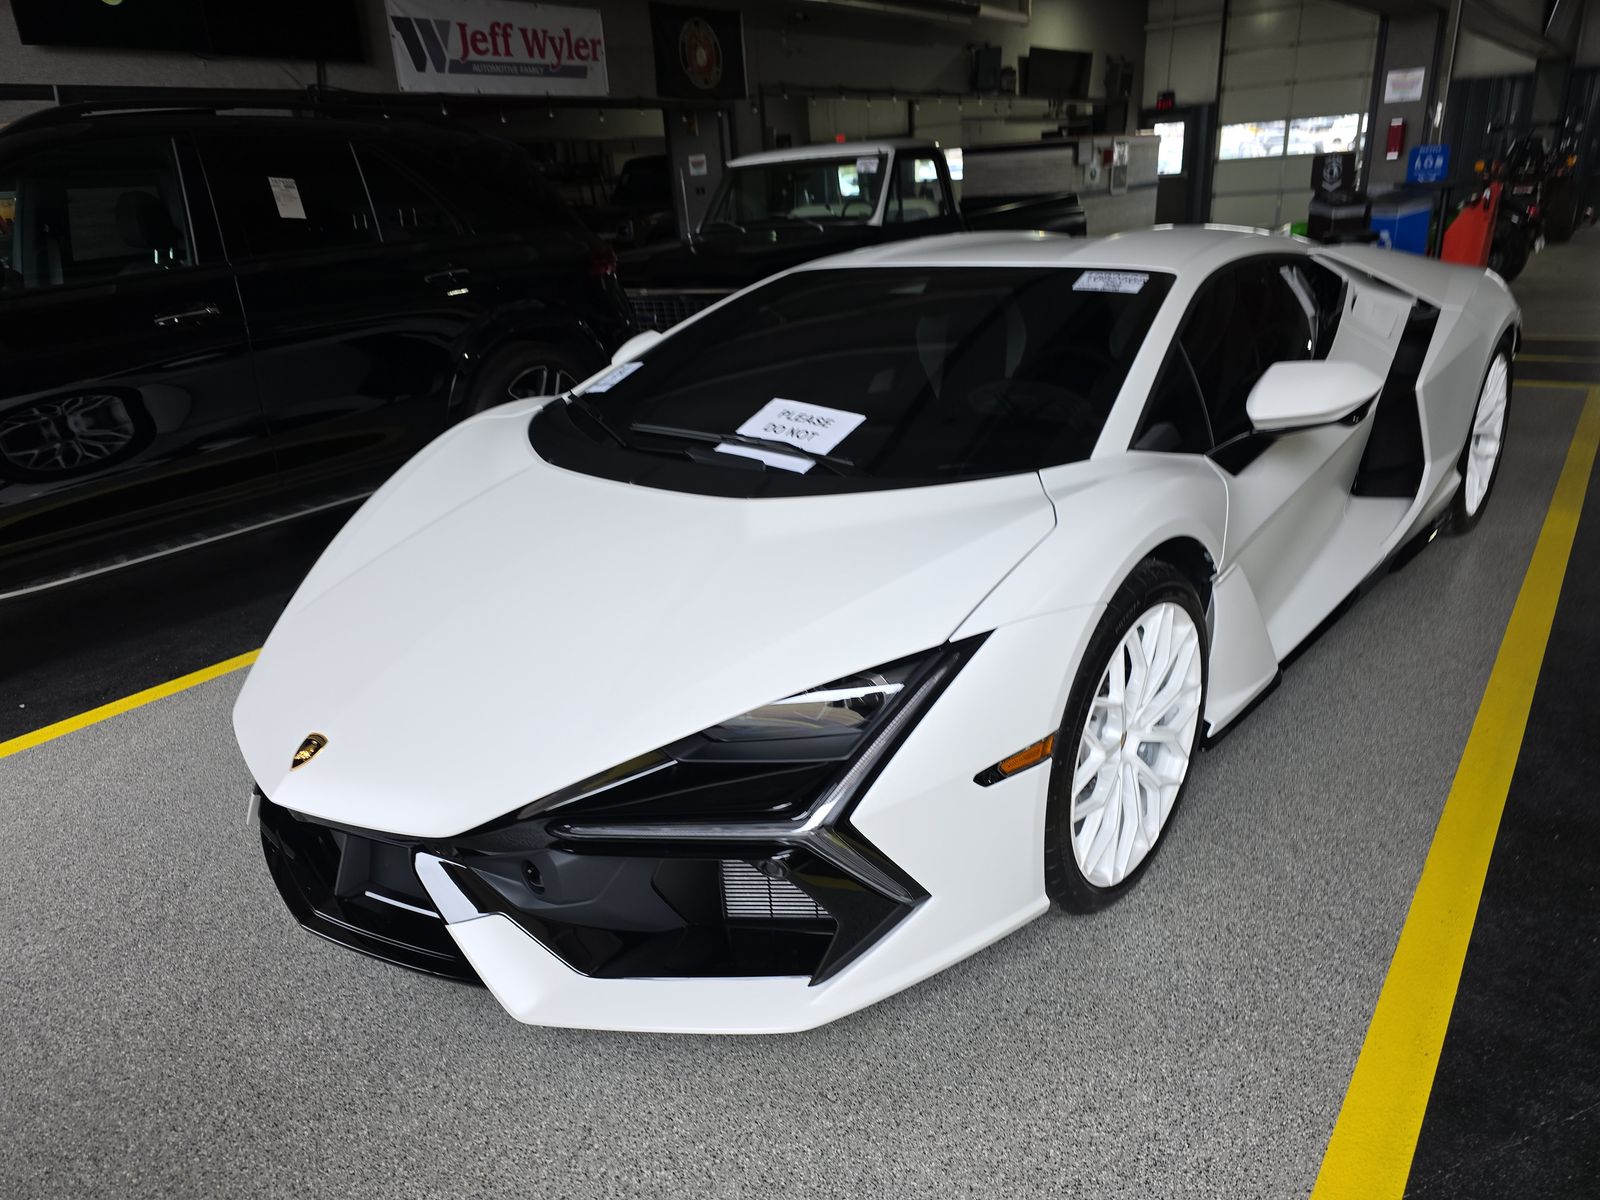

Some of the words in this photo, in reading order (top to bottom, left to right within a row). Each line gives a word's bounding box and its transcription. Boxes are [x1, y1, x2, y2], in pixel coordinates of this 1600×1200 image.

[456, 21, 513, 64] Jeff
[519, 27, 602, 73] Wyler
[472, 63, 519, 75] AUTOMOTIVE
[520, 65, 544, 76] FAMILY
[777, 409, 835, 428] PLEASE
[764, 422, 786, 434] DO
[786, 427, 819, 441] NOT
